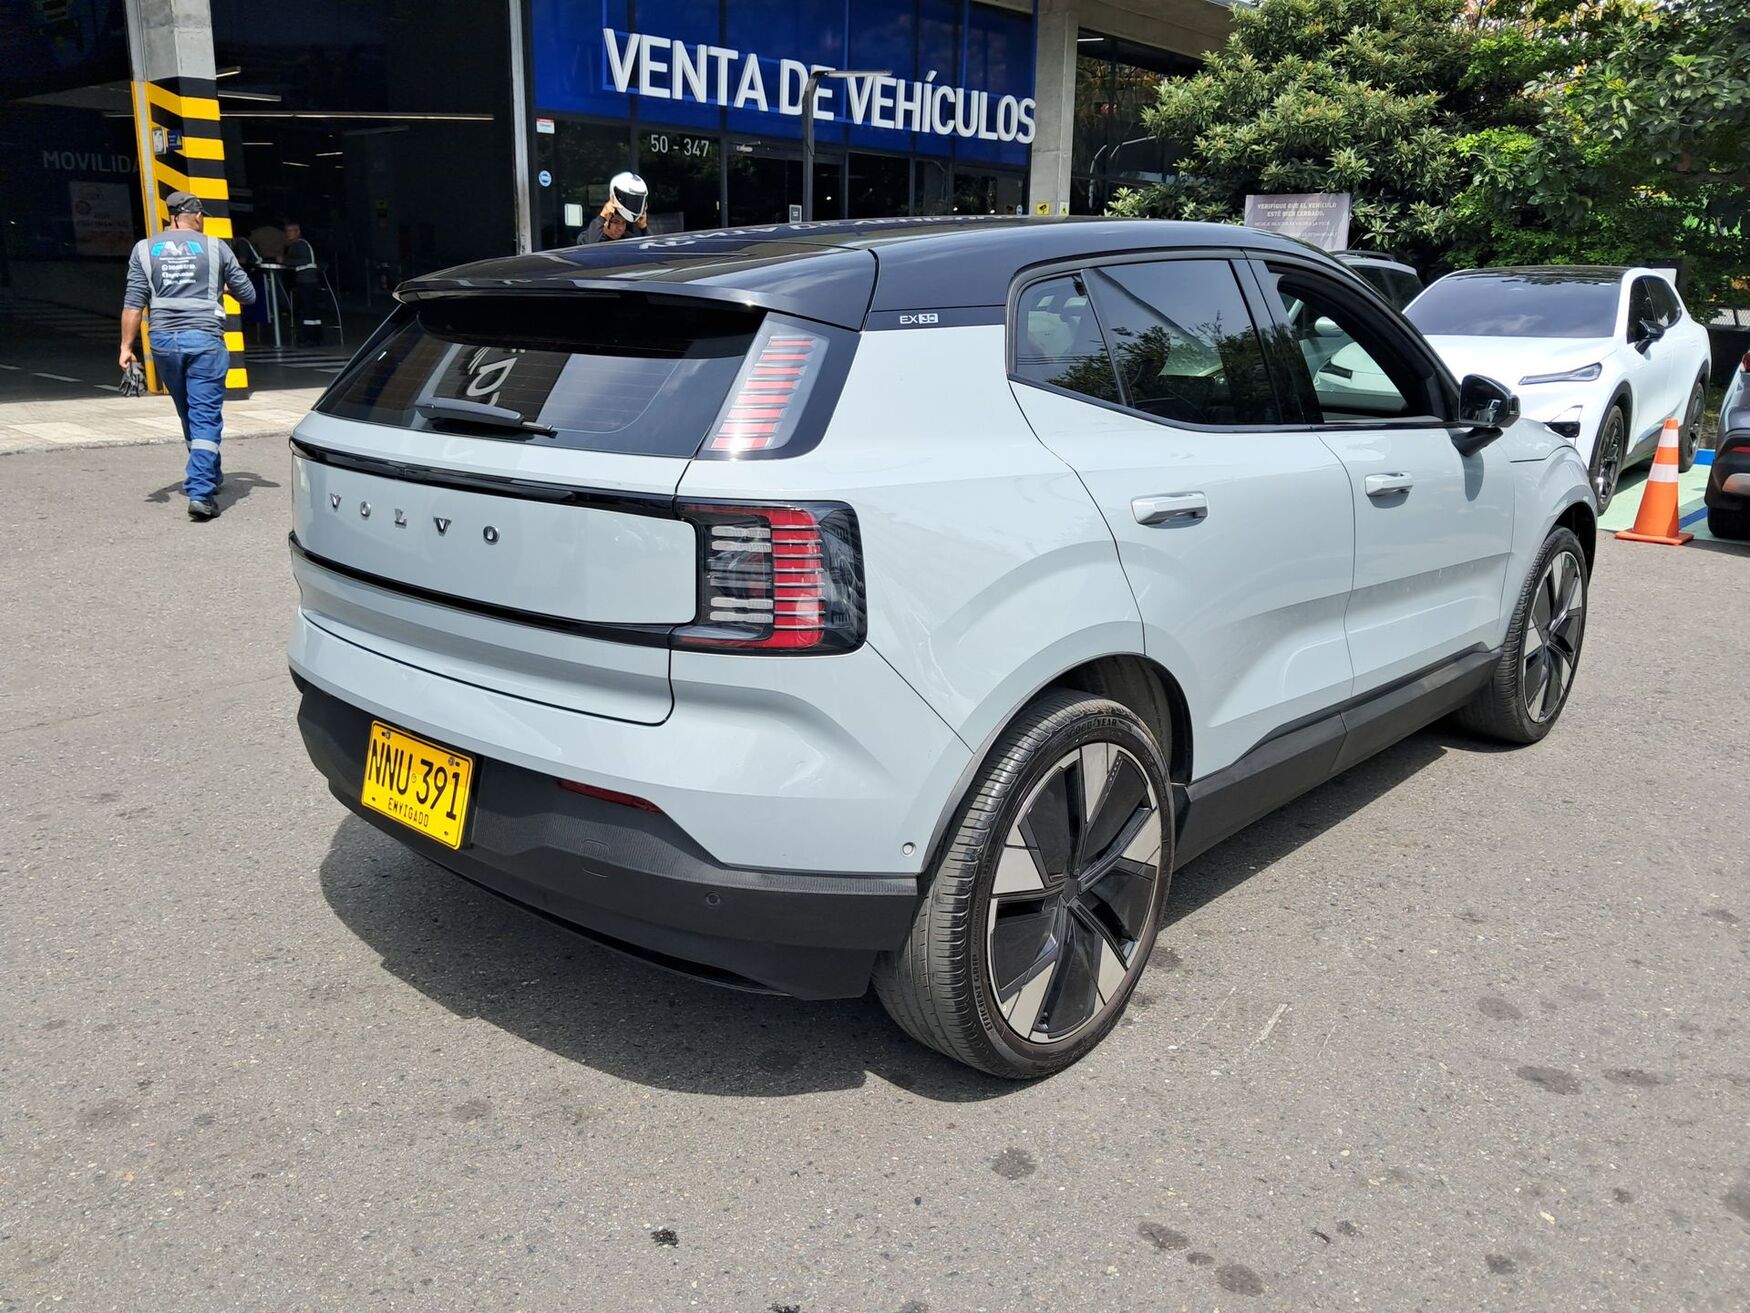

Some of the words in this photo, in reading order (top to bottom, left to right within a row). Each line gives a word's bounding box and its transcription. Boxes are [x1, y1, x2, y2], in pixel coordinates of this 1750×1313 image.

[603, 28, 769, 112] VENTA
[779, 58, 837, 121] DE
[847, 70, 1037, 144] VEHÍCULOS
[650, 134, 669, 153] 50
[683, 138, 710, 158] 347
[329, 493, 500, 543] VOLVO
[368, 738, 414, 796] NNU
[416, 758, 461, 821] 391
[387, 797, 430, 828] ENVIGADO
